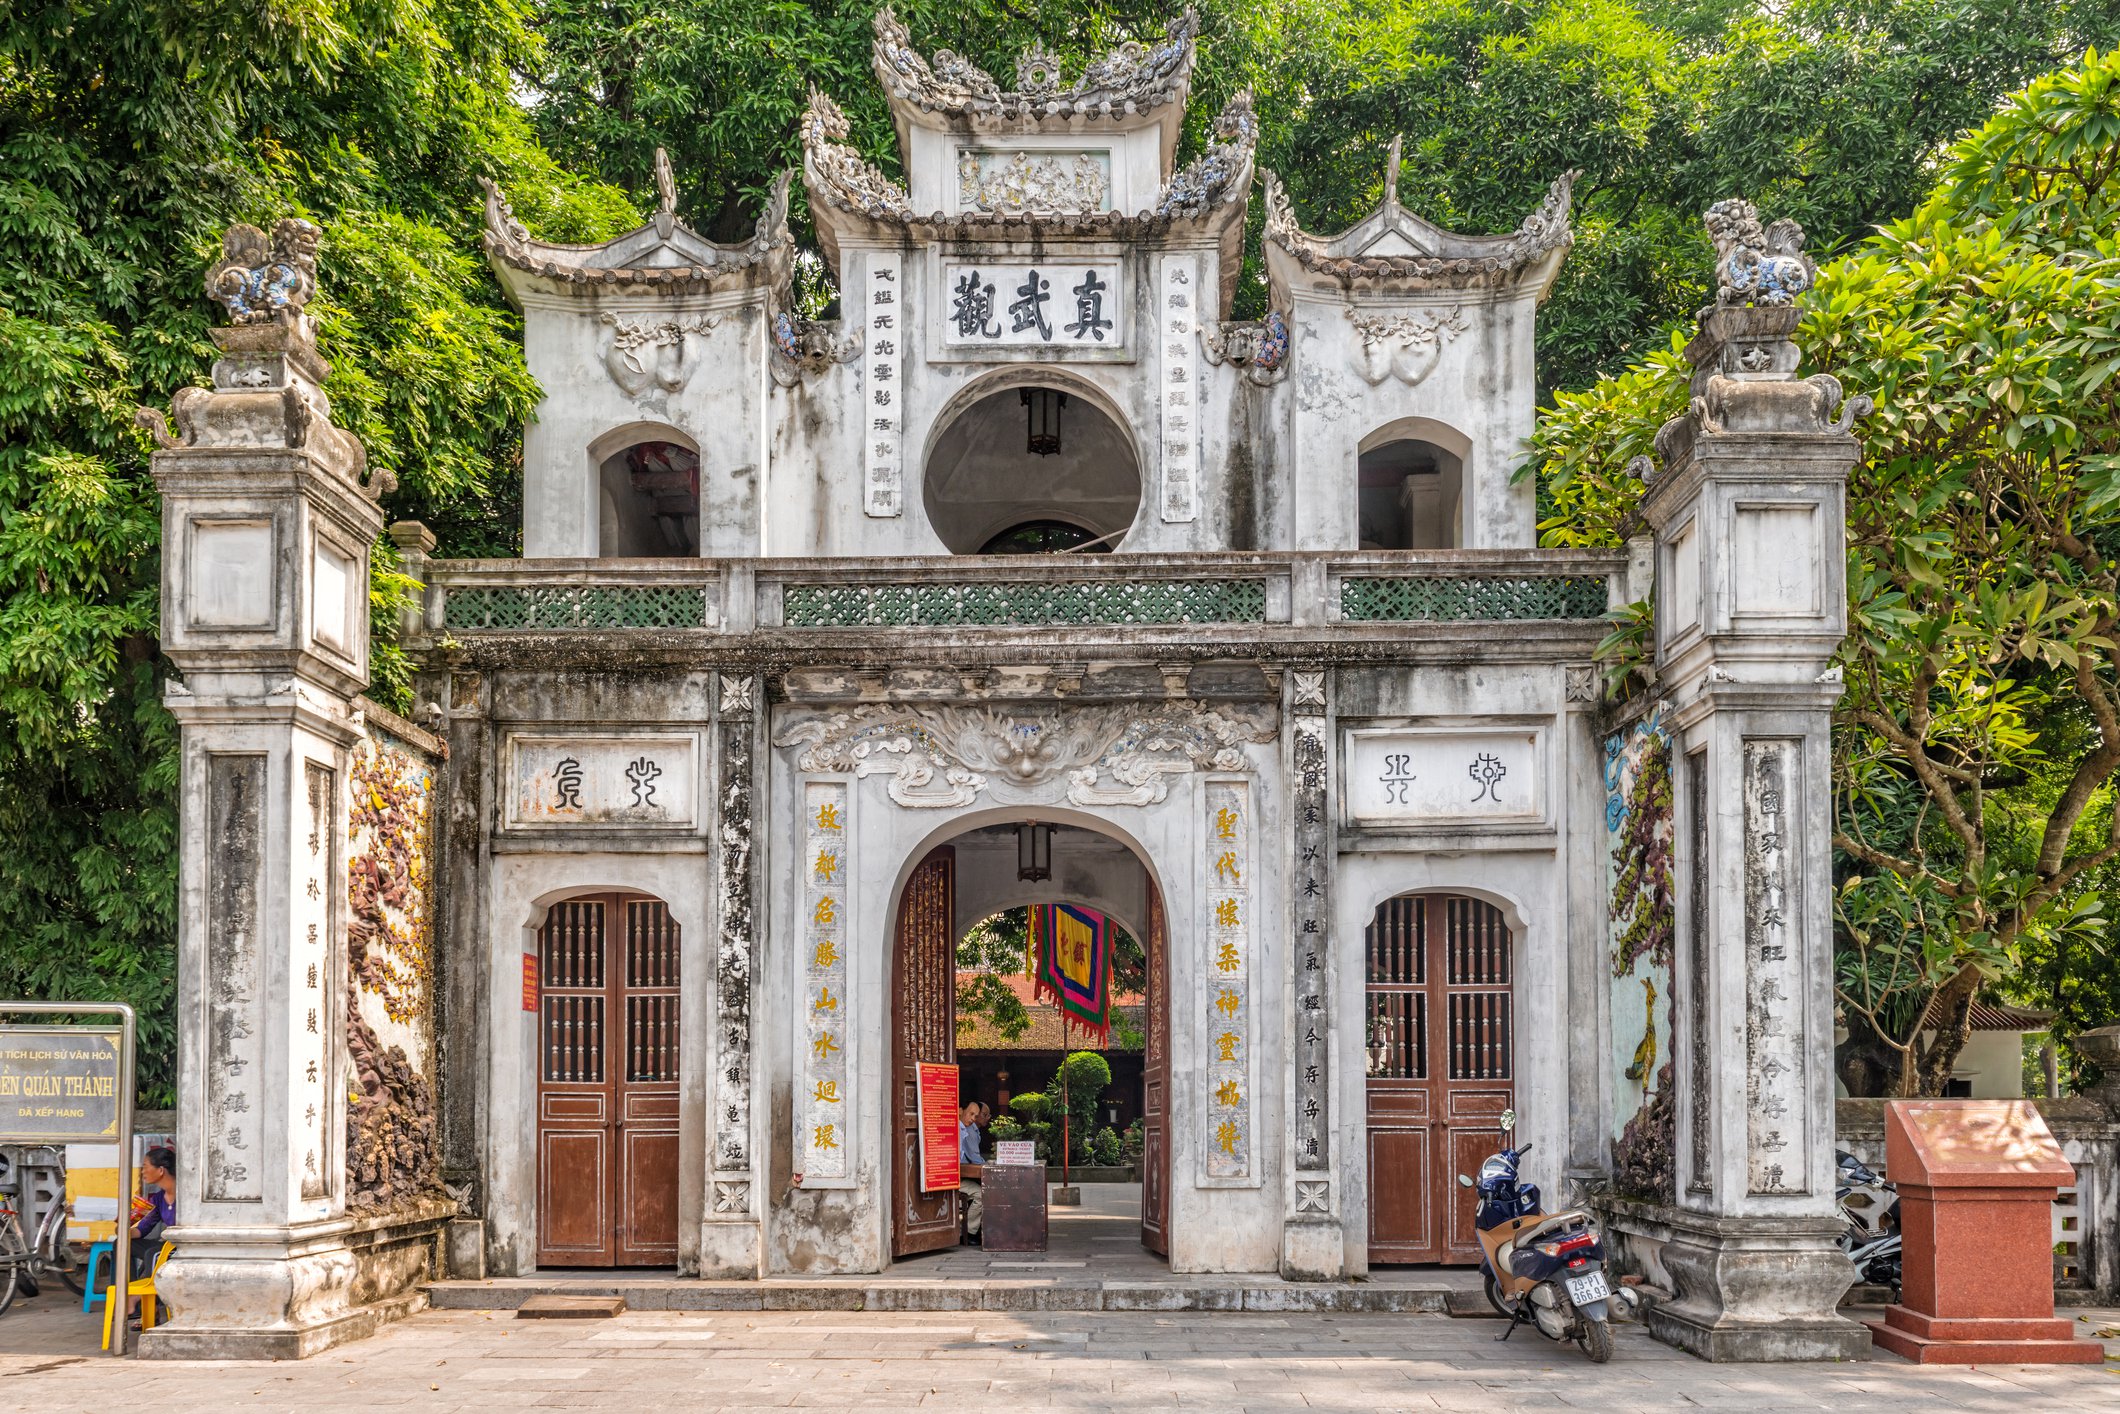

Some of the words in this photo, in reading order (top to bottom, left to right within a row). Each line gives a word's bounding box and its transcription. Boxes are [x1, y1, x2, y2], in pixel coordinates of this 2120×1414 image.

[949, 269, 1113, 341] 真武觀
[5, 1049, 27, 1059] TÍCH
[30, 1051, 52, 1061] LỊCH
[69, 1050, 90, 1060] VĂN
[92, 1049, 113, 1060] HÓA
[0, 1065, 21, 1096] ỀN
[23, 1070, 62, 1097] QUÁN
[65, 1070, 114, 1097] THÁNH
[18, 1106, 32, 1117] ĐÃ
[35, 1105, 54, 1117] XẾP
[56, 1109, 84, 1119] HẠNG
[1572, 1275, 1600, 1292] 29-P1
[1574, 1285, 1608, 1304] 366.93
